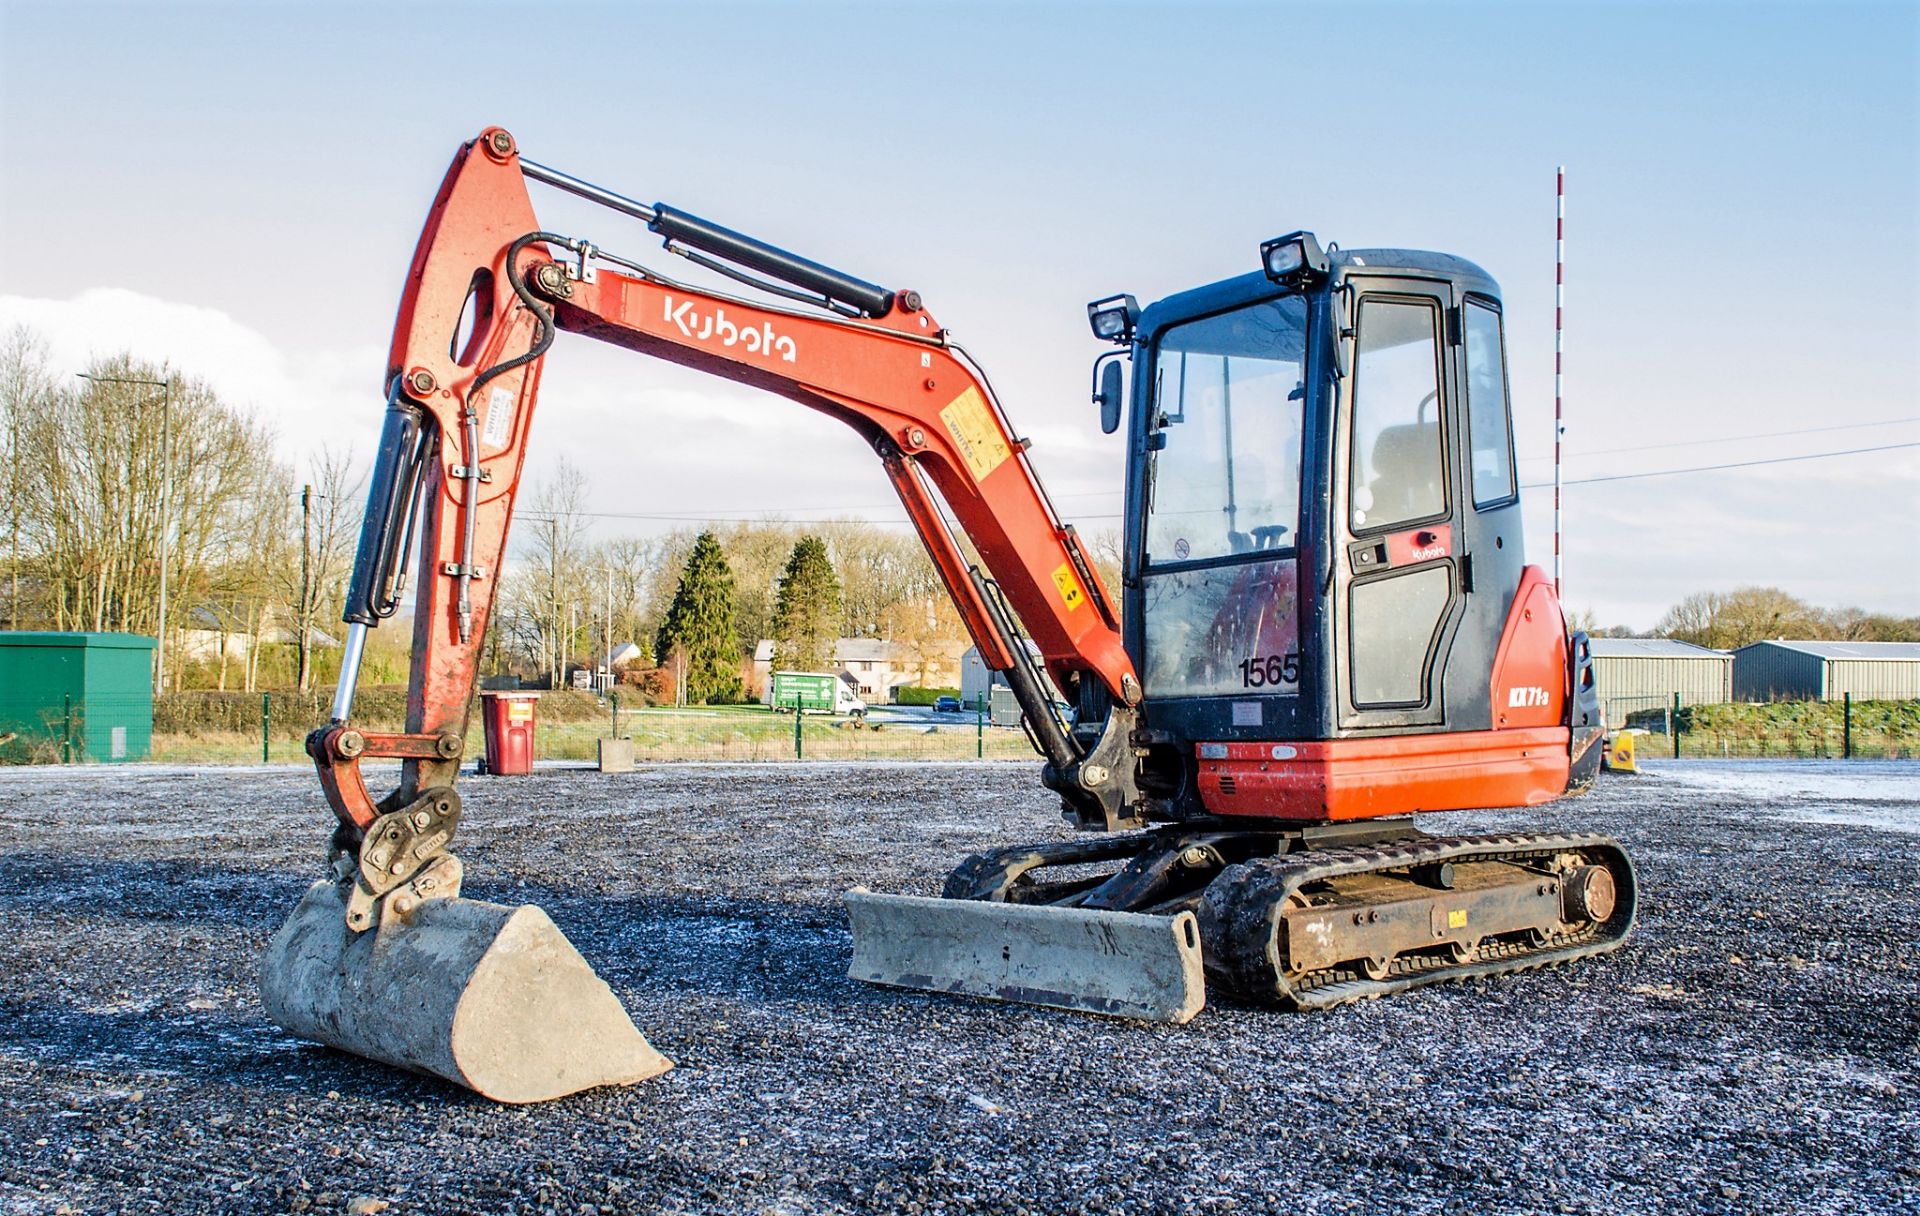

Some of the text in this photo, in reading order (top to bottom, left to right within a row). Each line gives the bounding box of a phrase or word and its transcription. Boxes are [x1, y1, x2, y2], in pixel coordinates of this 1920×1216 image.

[663, 295, 797, 363] Kubota
[950, 421, 974, 459] WHITES
[1412, 545, 1445, 560] Kubota
[1238, 653, 1299, 688] 1565
